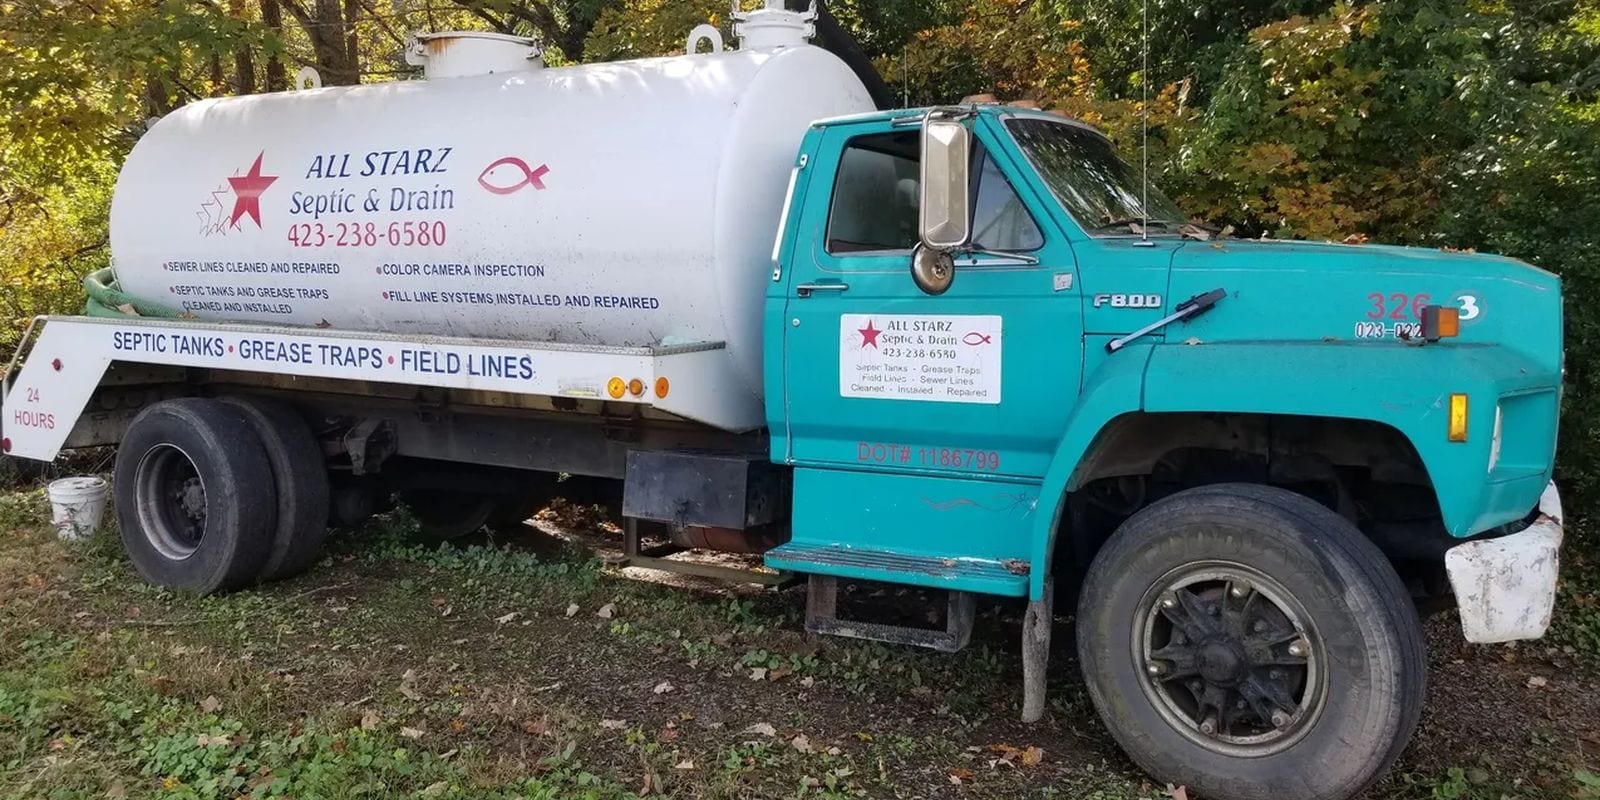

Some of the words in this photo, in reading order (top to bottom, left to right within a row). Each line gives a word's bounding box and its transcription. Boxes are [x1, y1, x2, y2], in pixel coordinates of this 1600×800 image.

[306, 154, 351, 179] ALL
[360, 147, 452, 176] STARZ
[289, 188, 356, 219] Septic
[363, 188, 379, 212] &
[390, 184, 454, 212] Drain
[287, 221, 446, 247] 423-238-6580
[168, 261, 198, 272] SEWER
[200, 262, 224, 272] LINES
[226, 262, 268, 273] CLEANED
[270, 262, 290, 273] AND
[292, 263, 340, 274] REPAIRED
[383, 264, 420, 275] COLOR
[423, 264, 472, 276] CAMERA
[474, 265, 545, 277] INSPECTION
[175, 285, 205, 296] SEPTIC
[207, 286, 235, 297] TANKS
[237, 287, 256, 297] AND
[256, 287, 295, 298] GREASE
[297, 288, 329, 300] TRAPS
[389, 291, 412, 302] FILL
[414, 291, 439, 303] LINE
[441, 292, 494, 304] SYSTEMS
[497, 293, 561, 306] INSTALLED
[565, 295, 591, 307] AND
[594, 296, 659, 309] REPAIRED
[1094, 294, 1161, 308] F800
[182, 301, 222, 312] CLEANED
[224, 302, 242, 312] AND
[244, 303, 293, 314] INSTALLED
[1457, 295, 1480, 320] 3
[887, 320, 908, 331] ALL
[913, 320, 953, 332] STARZ
[882, 334, 913, 346] Septic
[917, 335, 924, 344] &
[928, 335, 957, 346] Drain
[113, 331, 167, 352] SEPTIC
[171, 335, 224, 357] TANKS
[239, 339, 312, 364] GREASE
[318, 344, 383, 369] TRAPS
[401, 349, 460, 374] FIELD
[468, 354, 533, 379] LINES
[882, 347, 957, 359] 423-238-6580
[884, 364, 908, 373] Tanks
[921, 364, 953, 374] Grease
[957, 365, 981, 375] Traps
[885, 374, 907, 383] Lines
[920, 375, 947, 385] Sewer
[950, 376, 974, 386] Lines
[27, 387, 40, 403] 24
[851, 383, 885, 392] Cleaned
[898, 386, 933, 395] Installed
[947, 387, 987, 397] Repaired
[15, 410, 55, 430] HOURS
[857, 442, 912, 463] DOT#
[919, 447, 1000, 471] 1186799
